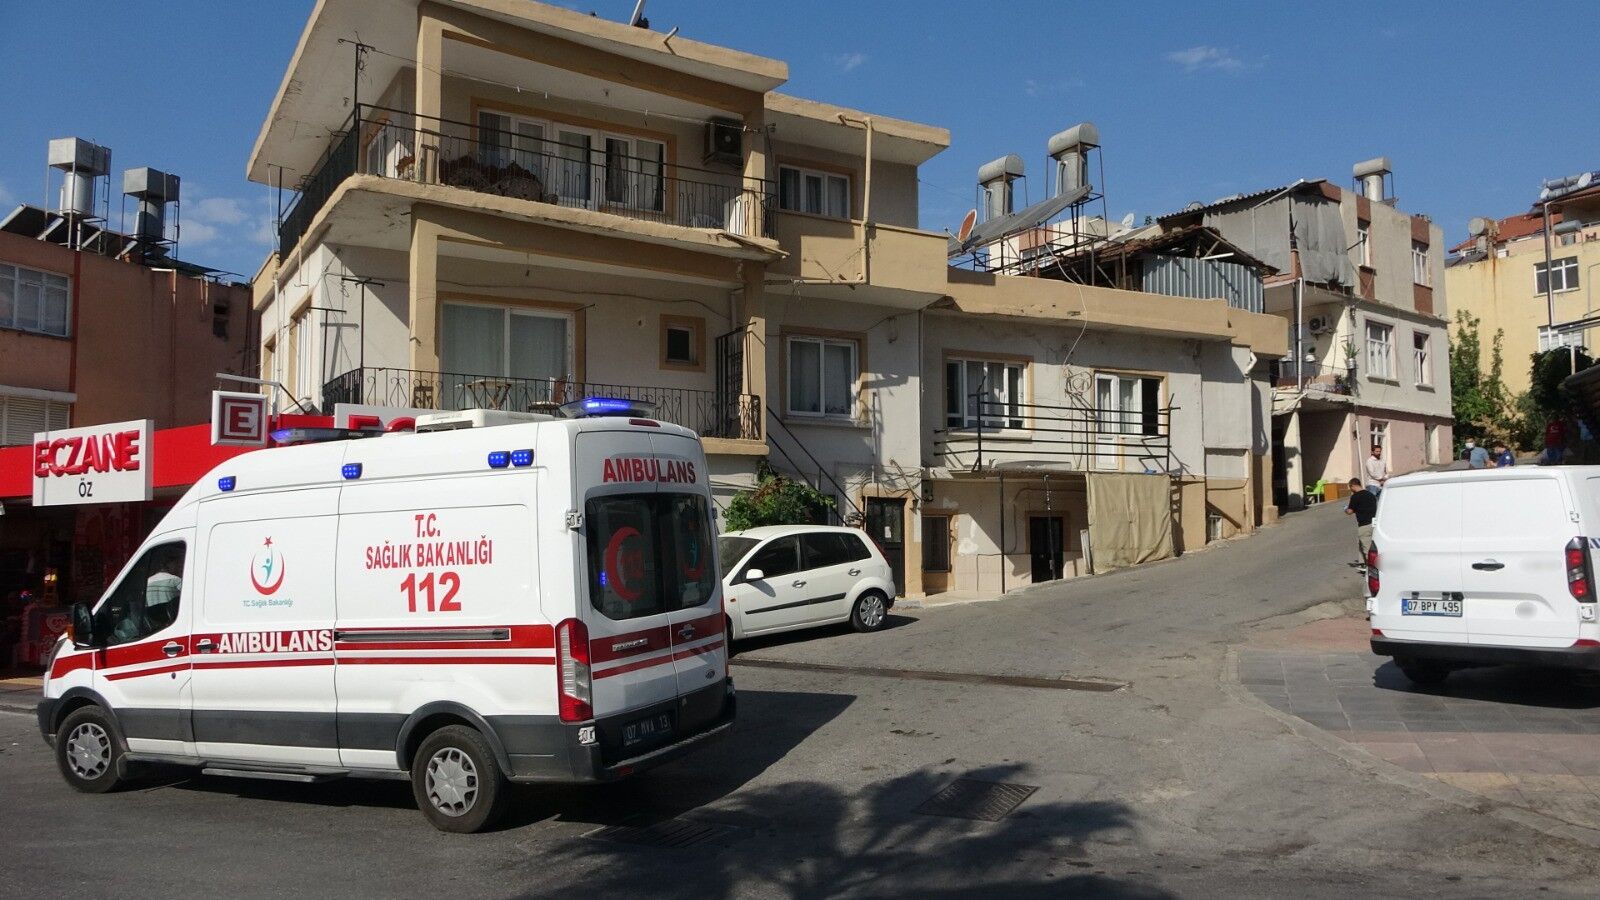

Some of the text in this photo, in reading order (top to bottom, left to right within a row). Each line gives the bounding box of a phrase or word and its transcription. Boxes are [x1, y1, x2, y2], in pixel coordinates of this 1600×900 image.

[230, 406, 252, 433] E
[35, 430, 140, 477] ECZANE
[603, 458, 696, 483] AMBULANS
[78, 478, 93, 498] ÖZ
[415, 513, 441, 538] T.C.
[366, 535, 493, 569] SAĞLIK BAKANLIĞI
[400, 572, 462, 613] 112
[1407, 601, 1459, 612] 07 BPY 495
[218, 630, 332, 653] AMBULANS
[627, 725, 636, 738] 07
